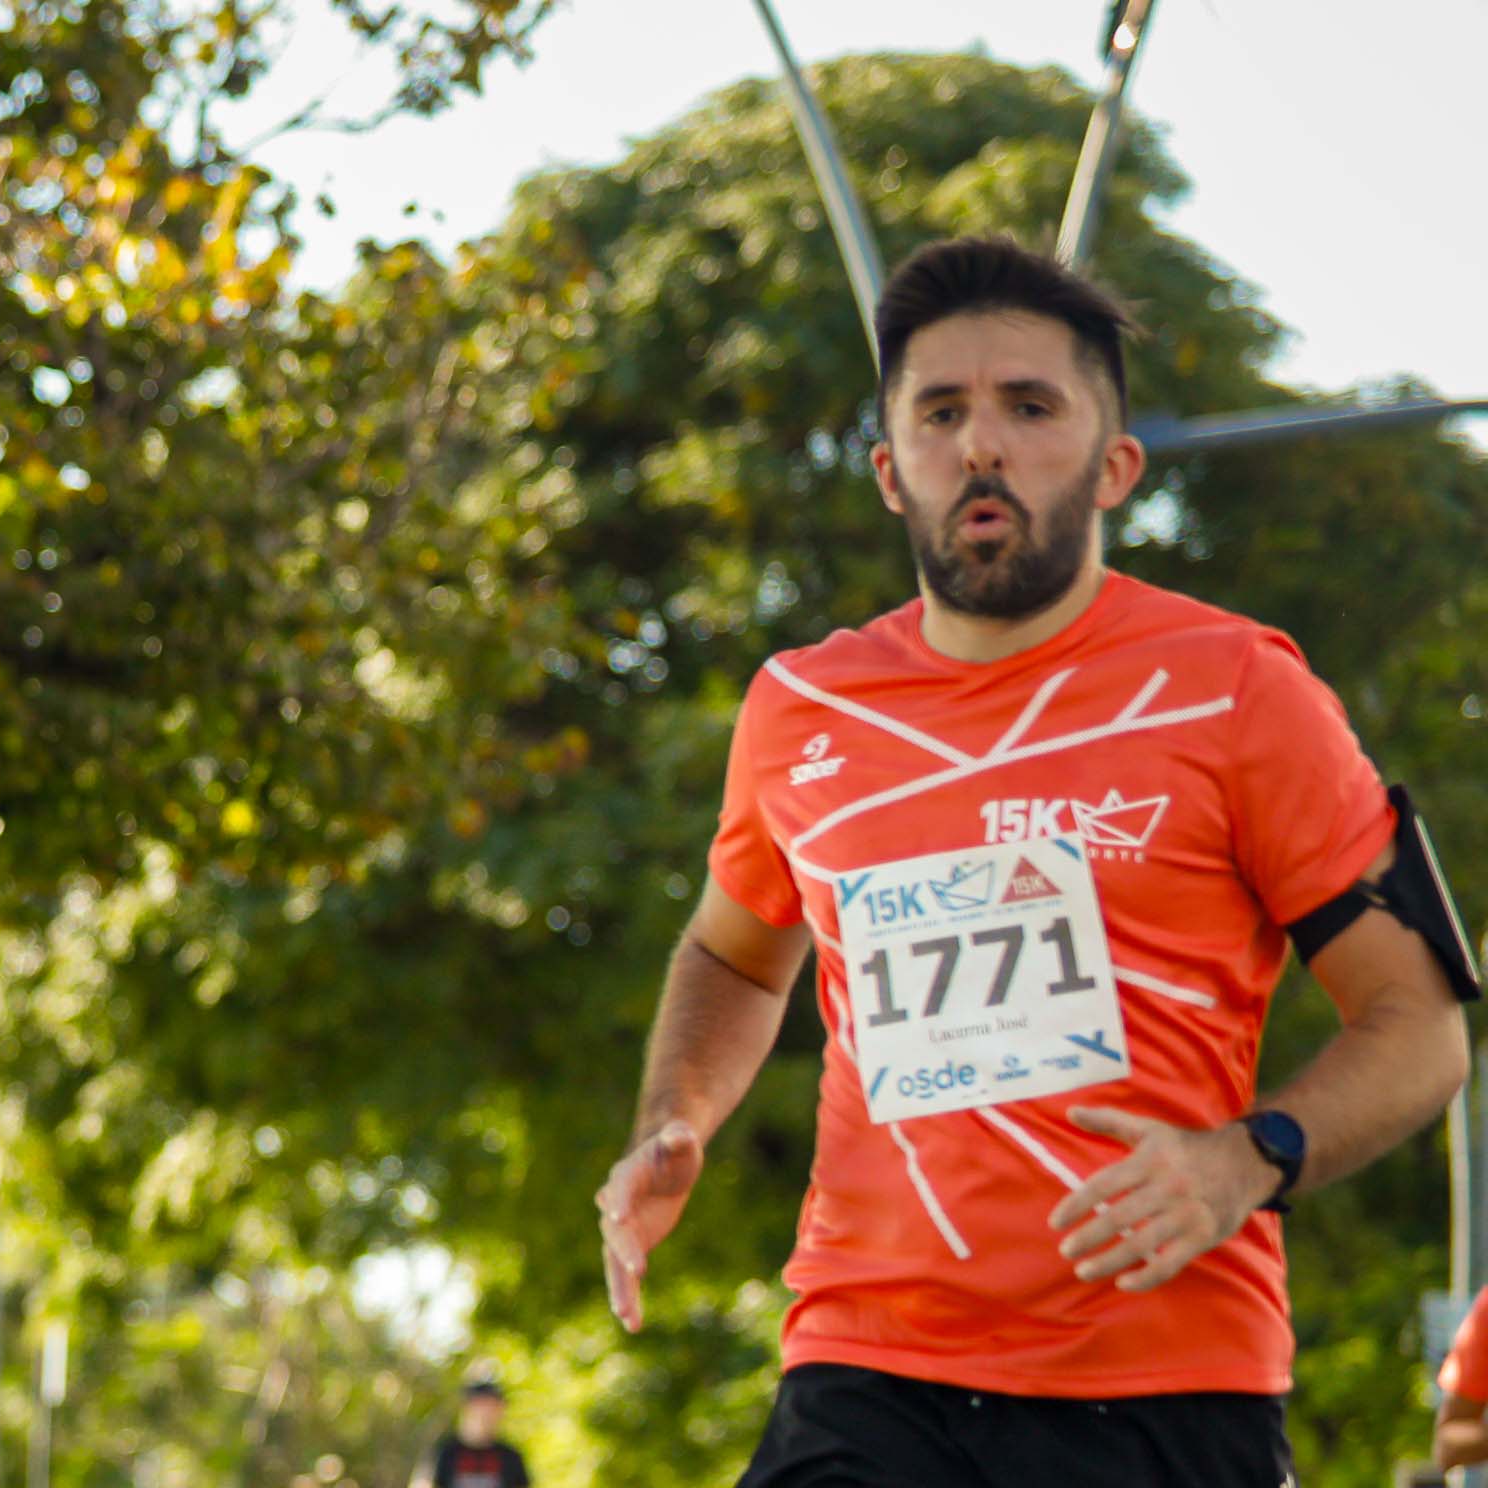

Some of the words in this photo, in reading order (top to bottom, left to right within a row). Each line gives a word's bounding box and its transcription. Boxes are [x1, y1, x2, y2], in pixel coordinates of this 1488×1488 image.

[980, 799, 1066, 843] 15K
[1087, 848, 1146, 864] ORTE
[864, 882, 926, 925] 15K
[861, 916, 1097, 1028] 1771
